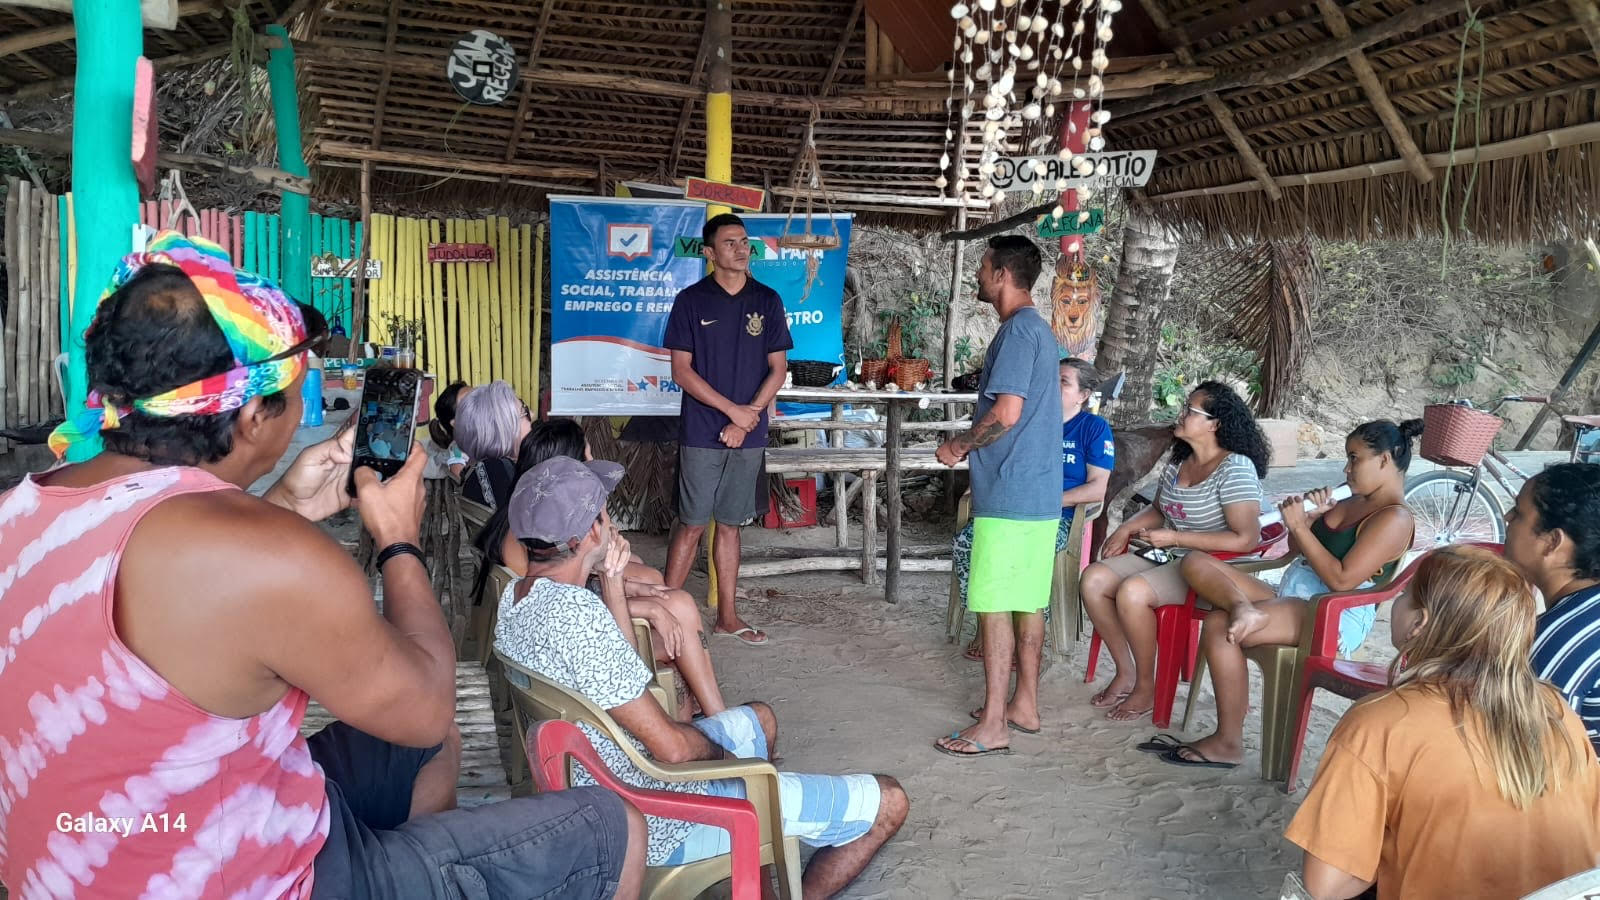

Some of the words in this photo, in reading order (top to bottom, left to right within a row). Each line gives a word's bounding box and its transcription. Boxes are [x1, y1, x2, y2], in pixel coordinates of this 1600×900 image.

[448, 29, 500, 88] JAH
[351, 268, 380, 279] AOR
[584, 267, 672, 281] ASSISTÊNCIA
[561, 284, 615, 297] SOCIAL,
[619, 285, 682, 297] TRABALH
[564, 300, 632, 312] EMPREGO
[635, 301, 644, 312] E
[646, 302, 673, 312] REN
